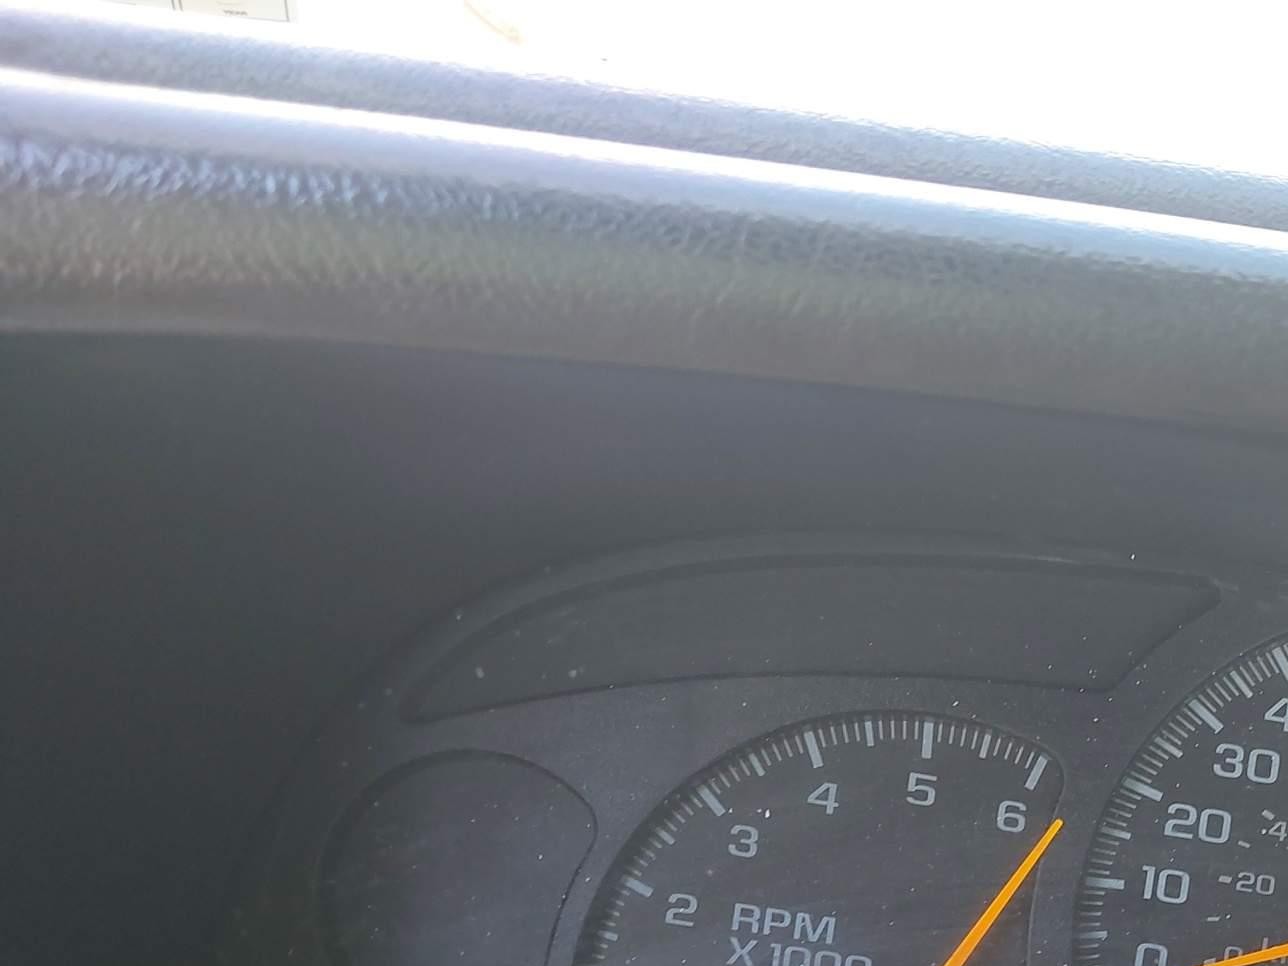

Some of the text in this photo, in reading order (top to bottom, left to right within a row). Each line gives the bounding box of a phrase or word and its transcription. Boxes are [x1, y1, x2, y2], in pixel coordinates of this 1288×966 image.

[1212, 743, 1280, 784] 30
[806, 781, 840, 815] 4
[905, 771, 938, 808] 5
[995, 800, 1028, 834] 6
[1163, 803, 1232, 844] 20
[727, 824, 760, 858] 3
[1141, 865, 1190, 905] 10
[1235, 871, 1276, 896] 20
[664, 893, 699, 928] 2
[730, 902, 837, 945] RPM
